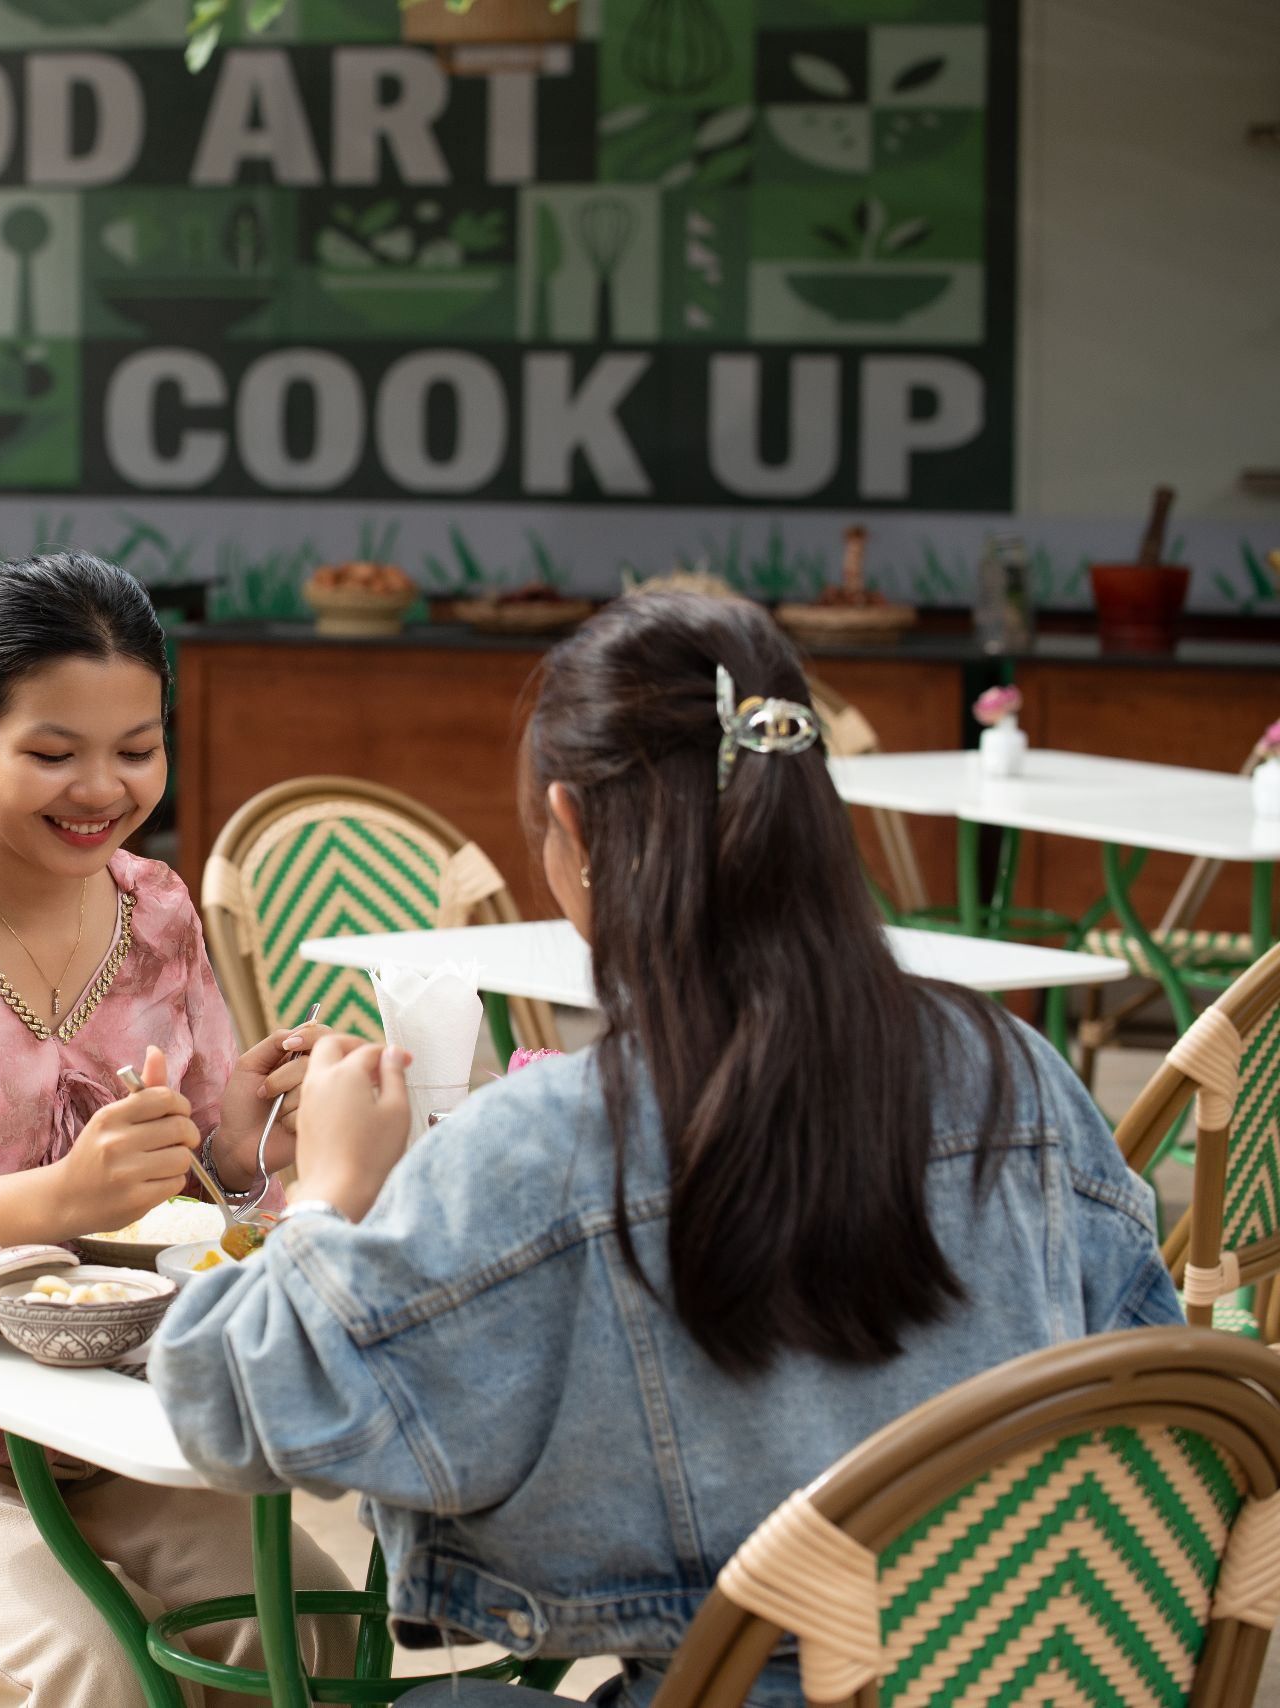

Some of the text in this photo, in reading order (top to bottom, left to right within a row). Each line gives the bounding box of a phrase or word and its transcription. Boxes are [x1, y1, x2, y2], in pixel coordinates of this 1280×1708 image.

[190, 47, 574, 186] ART
[105, 348, 986, 499] COOK UP
